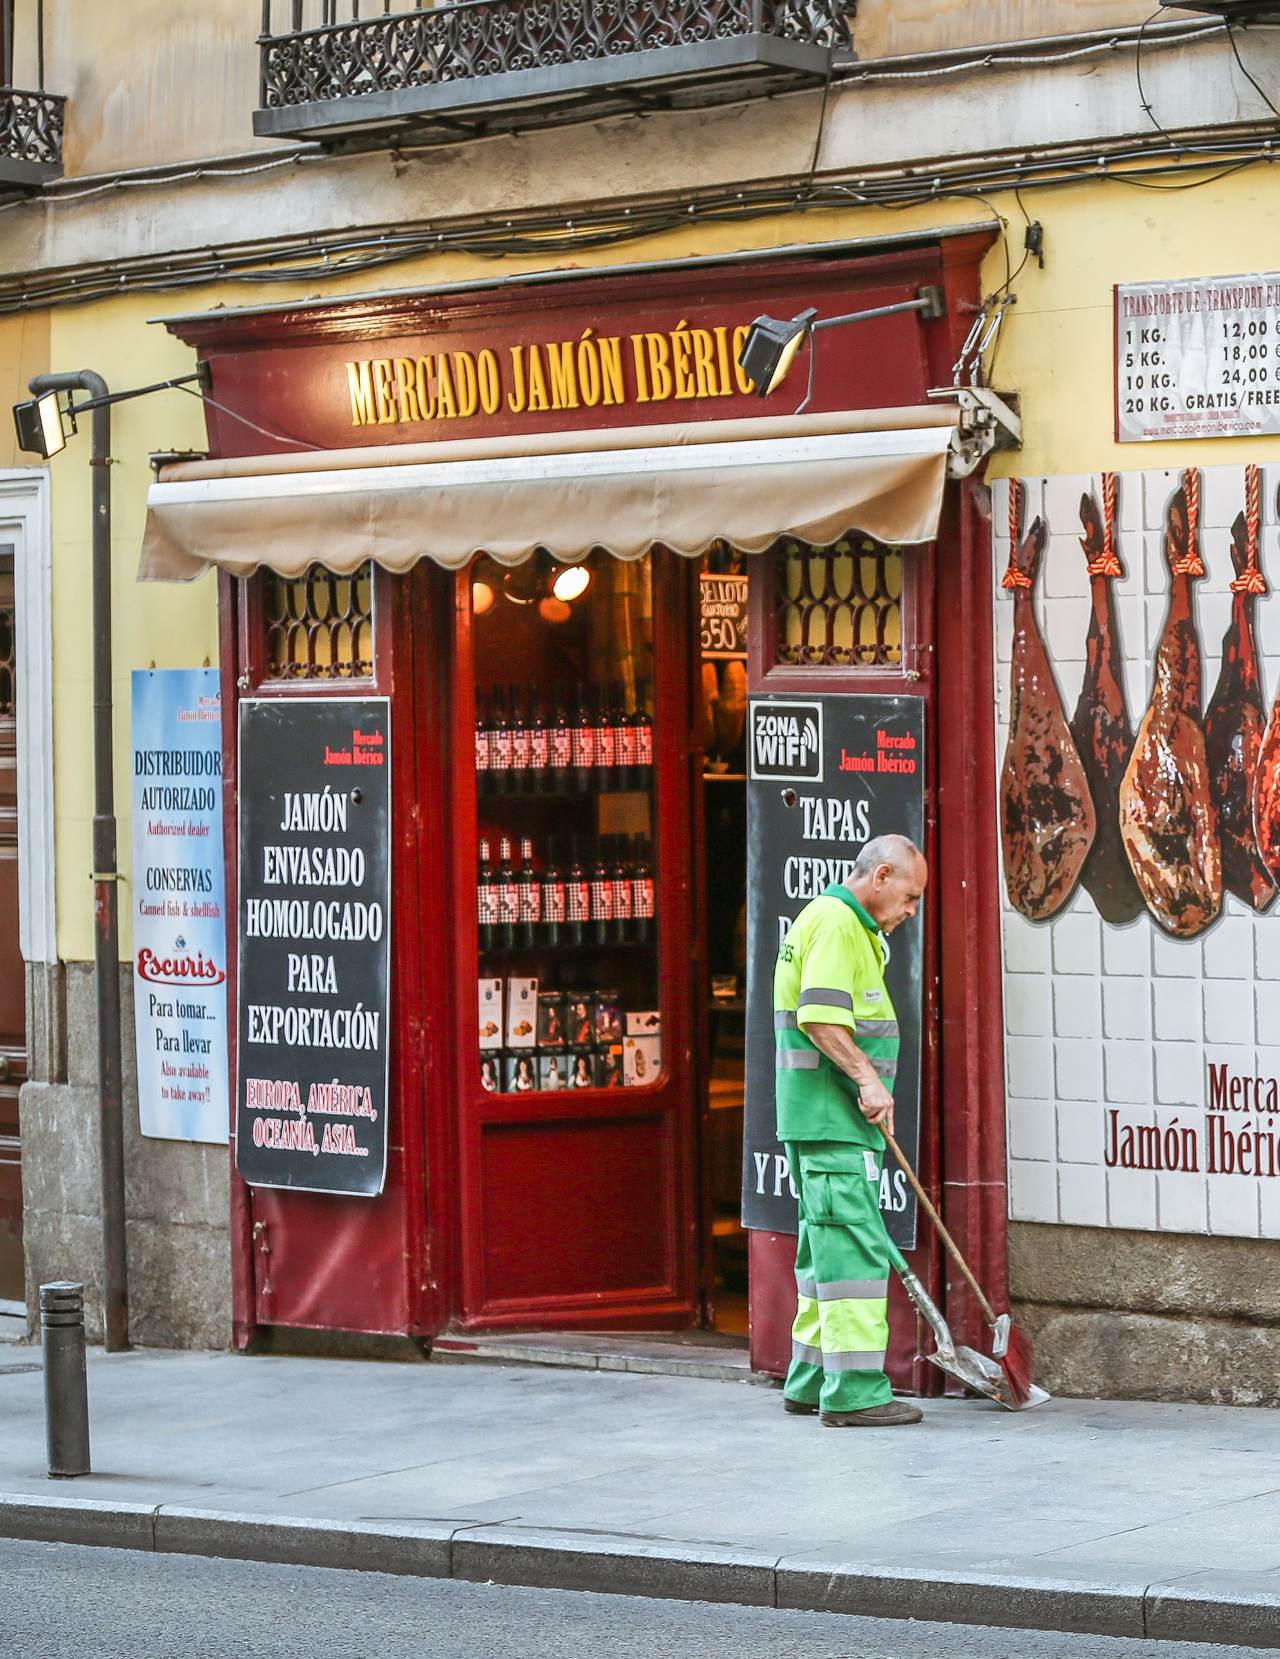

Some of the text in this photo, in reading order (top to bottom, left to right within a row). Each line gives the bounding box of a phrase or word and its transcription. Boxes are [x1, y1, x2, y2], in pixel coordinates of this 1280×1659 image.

[1123, 292, 1183, 318] TRANSPORTE
[1186, 290, 1203, 313] U.E.
[1206, 285, 1263, 311] TRANSPORT
[1126, 330, 1132, 345] 1
[1141, 328, 1167, 344] KG.
[1223, 320, 1268, 340] 12,00
[1125, 353, 1134, 368] 5
[1141, 351, 1166, 367] KG.
[1223, 344, 1268, 363] 18,00
[345, 319, 757, 427] MERCADO JAMÓN IBÉRIC
[1126, 375, 1144, 391] 10
[1151, 374, 1176, 389] KG.
[1221, 367, 1268, 386] 24,00
[1126, 389, 1280, 413] 20 KG. GRATIS/FREE
[353, 729, 384, 746] Mercado
[756, 716, 800, 737] ZONA
[877, 730, 916, 749] Mercado
[135, 750, 221, 776] DISTRIBUIDOR
[324, 746, 384, 765] Jamón Ibérico
[756, 735, 807, 767] WiFi
[838, 749, 916, 774] Jamón Ibérico
[141, 787, 215, 811] AUTORIZADO
[280, 785, 348, 832] JAMÓN
[147, 820, 210, 837] Authorized dealer
[799, 796, 871, 843] TAPAS
[146, 867, 212, 892] CONSERVAS
[263, 846, 366, 887] ENVASADO
[784, 856, 856, 900] CERVE
[139, 898, 220, 918] Canned fish & shellfish
[246, 898, 383, 942] HOMOLOGADO
[137, 947, 225, 984] Escuris
[287, 953, 338, 994] PARA
[149, 993, 216, 1020] Para tomar...
[247, 1002, 380, 1051] EXPORTACIÓN
[156, 1027, 212, 1054] Para llevar
[161, 1060, 210, 1079] Also available
[161, 1085, 211, 1105] to take away!!
[246, 1078, 378, 1122] EUROPA, AMÉRICA,
[252, 1115, 369, 1157] OCEANÍA, ASIA...
[1104, 1110, 1200, 1172] Jamón
